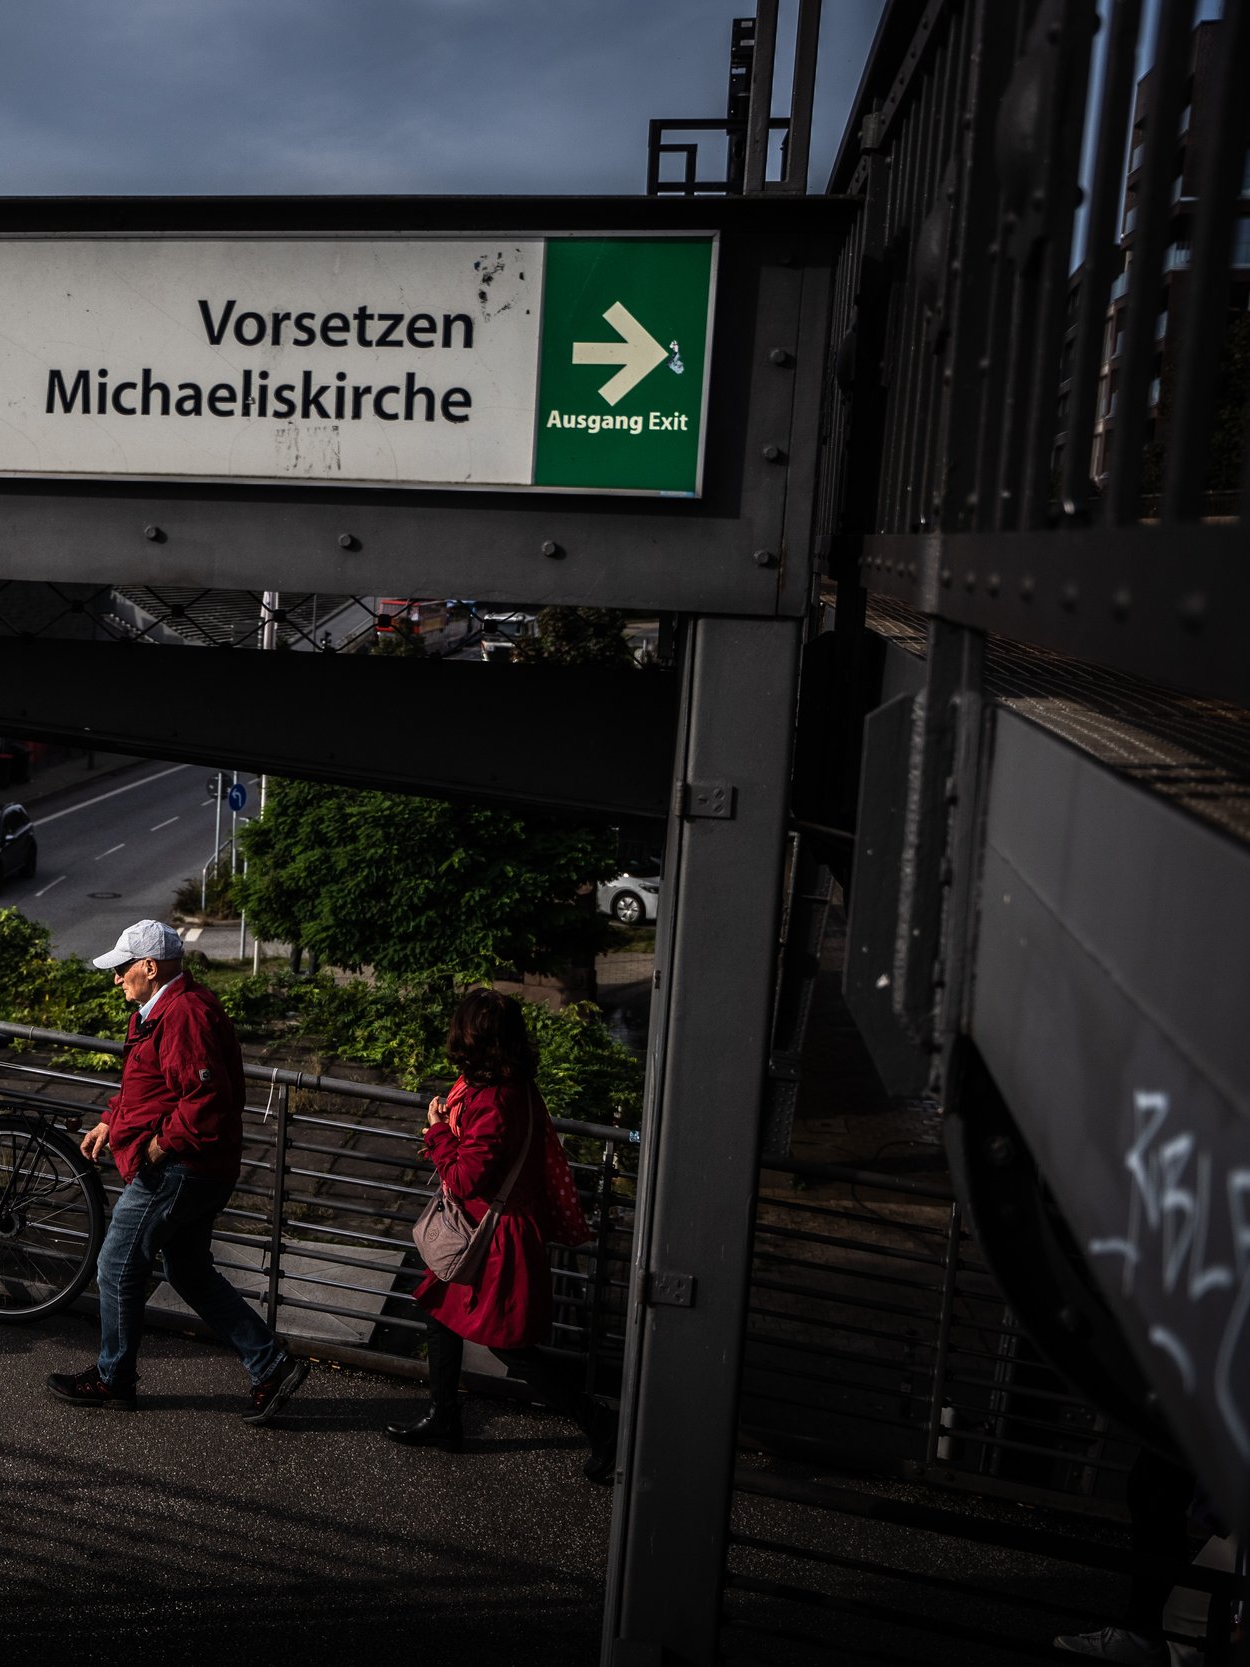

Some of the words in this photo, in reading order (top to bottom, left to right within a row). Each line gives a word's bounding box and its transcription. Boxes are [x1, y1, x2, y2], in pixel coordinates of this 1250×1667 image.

[198, 299, 474, 349] Vorsetzen
[45, 367, 473, 424] Michaeliskirche
[546, 409, 644, 435] Ausgang
[648, 411, 689, 431] Exit
